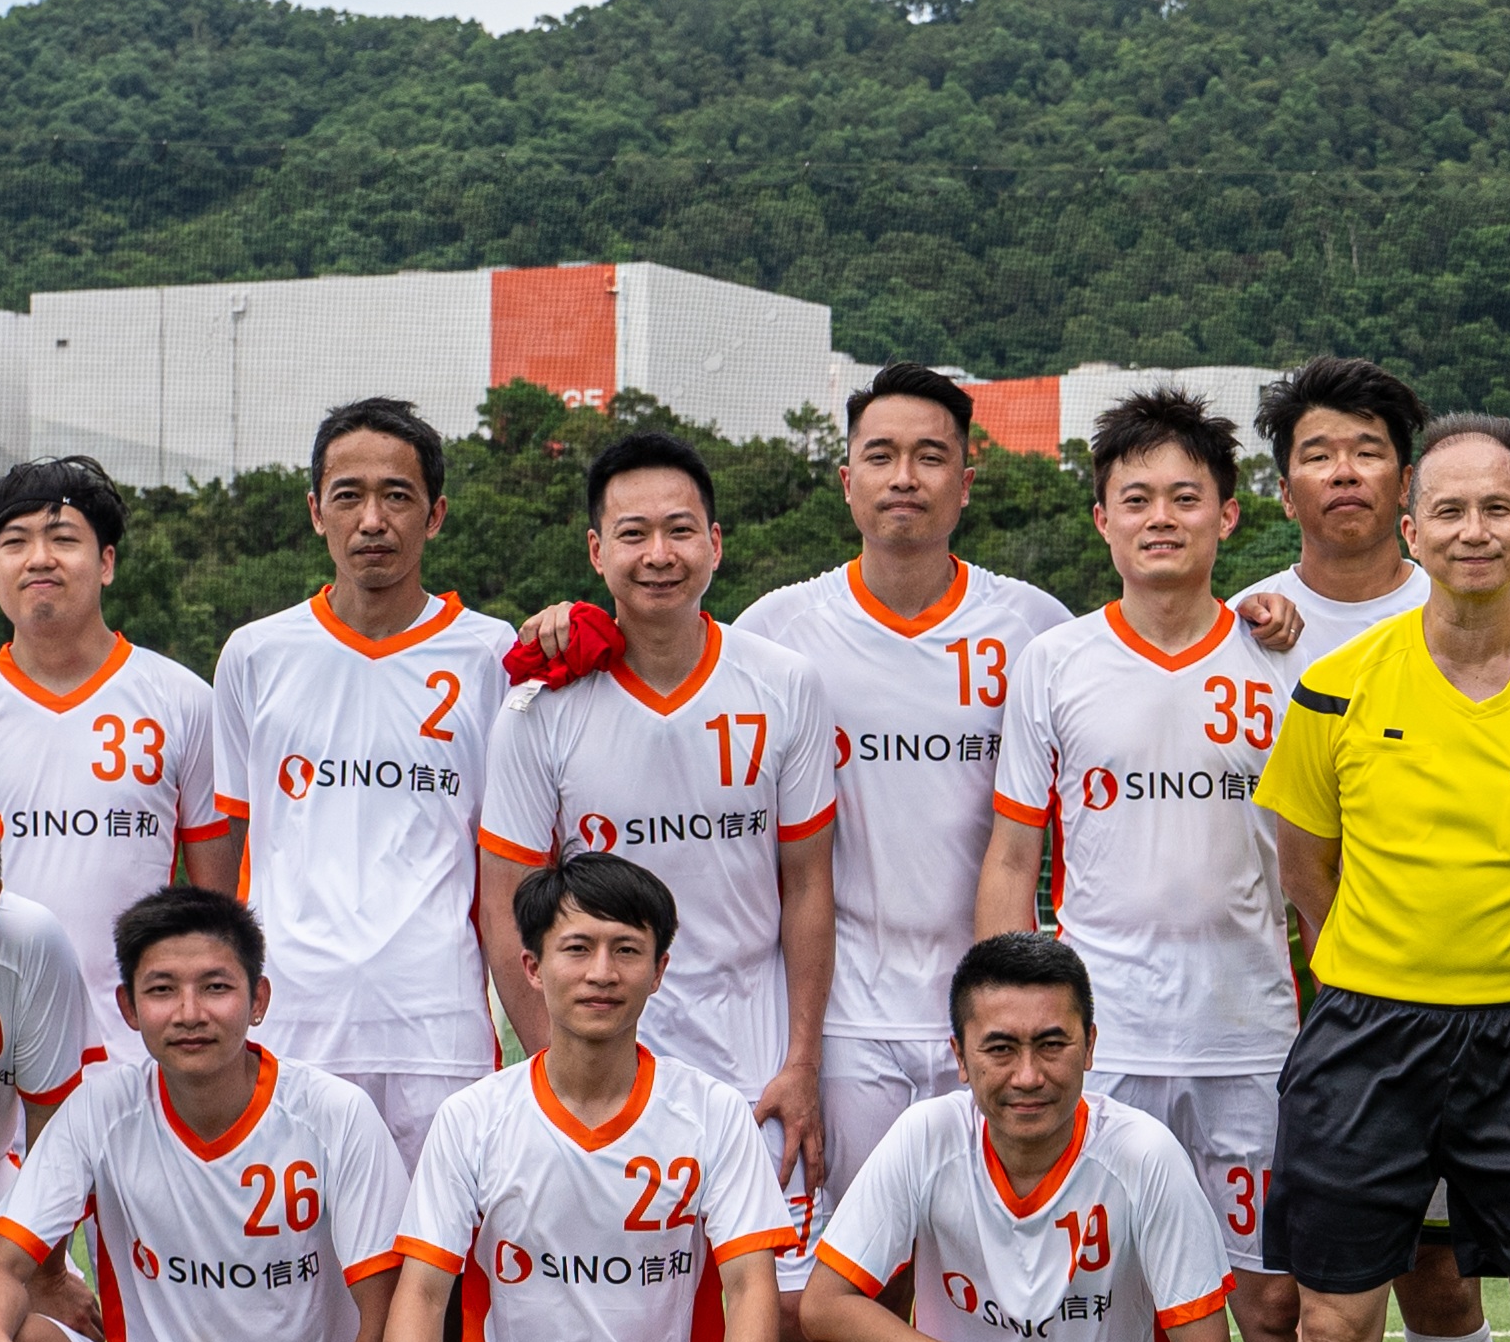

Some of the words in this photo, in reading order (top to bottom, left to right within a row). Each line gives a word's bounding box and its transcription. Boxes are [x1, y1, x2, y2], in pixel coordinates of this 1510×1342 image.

[420, 670, 461, 742] 2
[945, 638, 1008, 707] 13
[1204, 675, 1274, 750] 35
[91, 714, 165, 785] 33
[316, 758, 402, 788] SINO
[408, 762, 460, 797] 信和
[705, 713, 767, 787] 17
[859, 734, 951, 762] SINO
[1125, 770, 1214, 799] SINO
[11, 809, 98, 838] SINO
[104, 809, 159, 838] 信和
[625, 814, 712, 845] SINO
[716, 808, 767, 840] 信和
[240, 1160, 320, 1237] 26
[623, 1155, 701, 1232] 22
[1226, 1166, 1272, 1236] 3
[168, 1257, 257, 1289] SINO
[261, 1251, 321, 1290] 信和
[541, 1252, 632, 1285] SINO
[638, 1248, 693, 1287] 信和
[1055, 1203, 1112, 1283] 19
